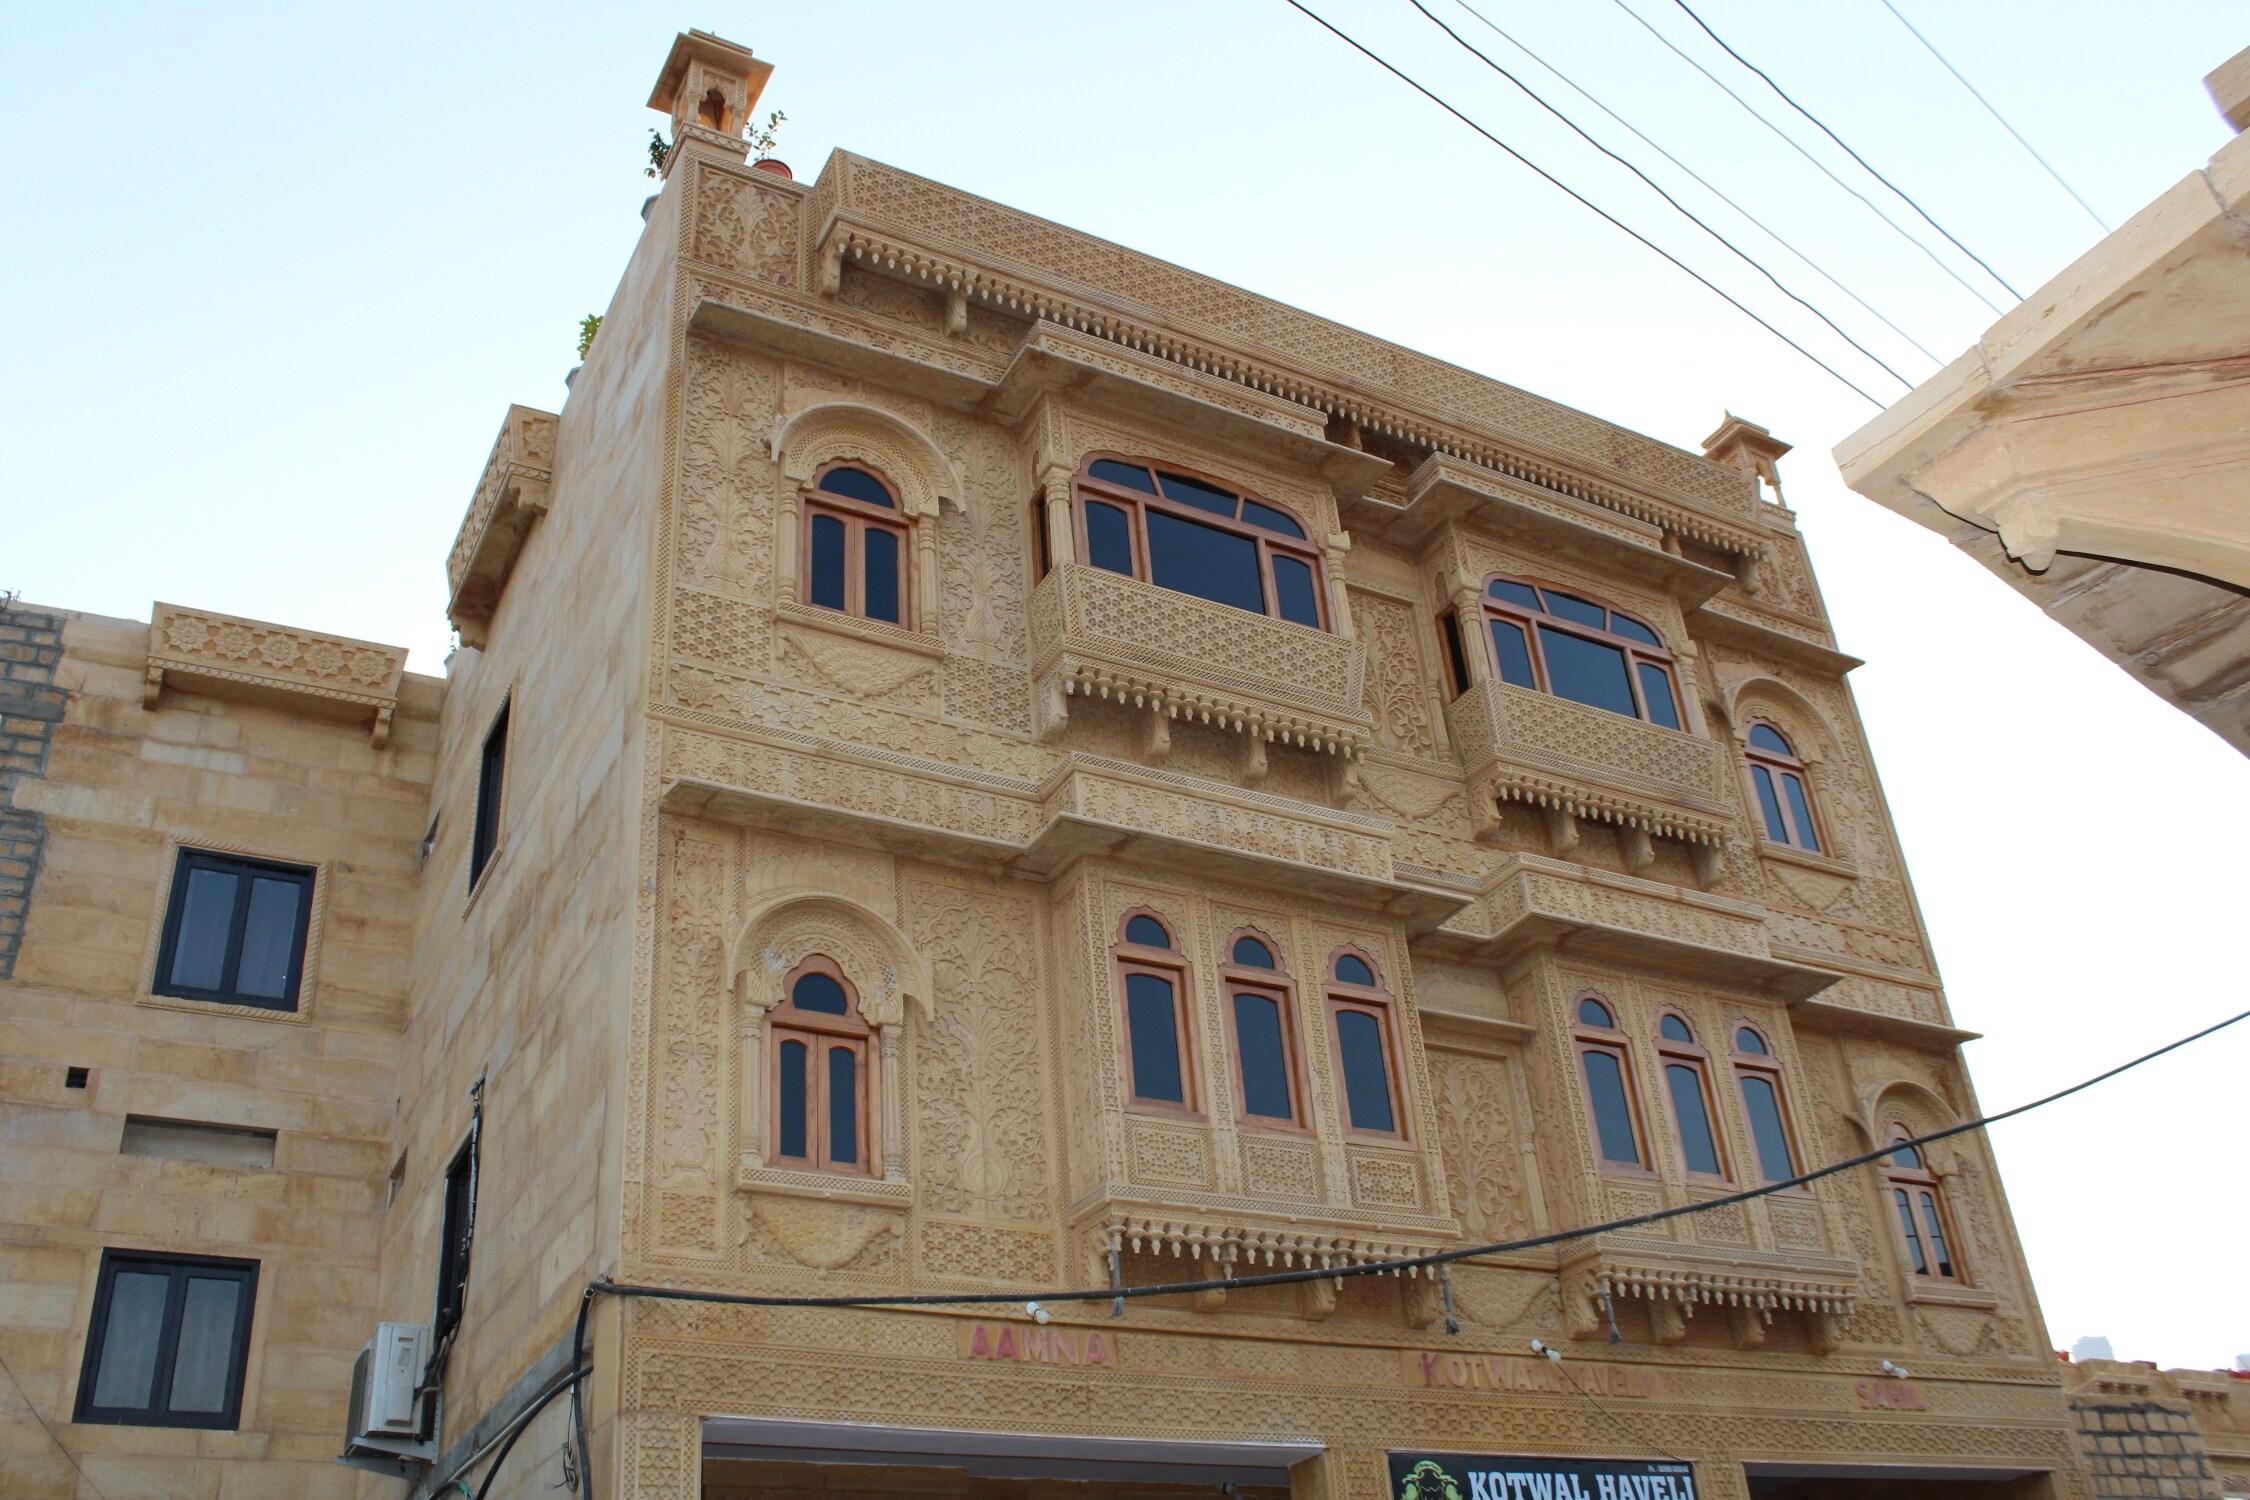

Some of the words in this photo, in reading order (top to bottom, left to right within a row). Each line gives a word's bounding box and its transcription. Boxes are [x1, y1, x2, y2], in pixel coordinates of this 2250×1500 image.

[968, 1325, 1111, 1368] AAMNA
[1467, 1471, 1590, 1500] KOTWAL
[1595, 1474, 1695, 1500] HAVELI
